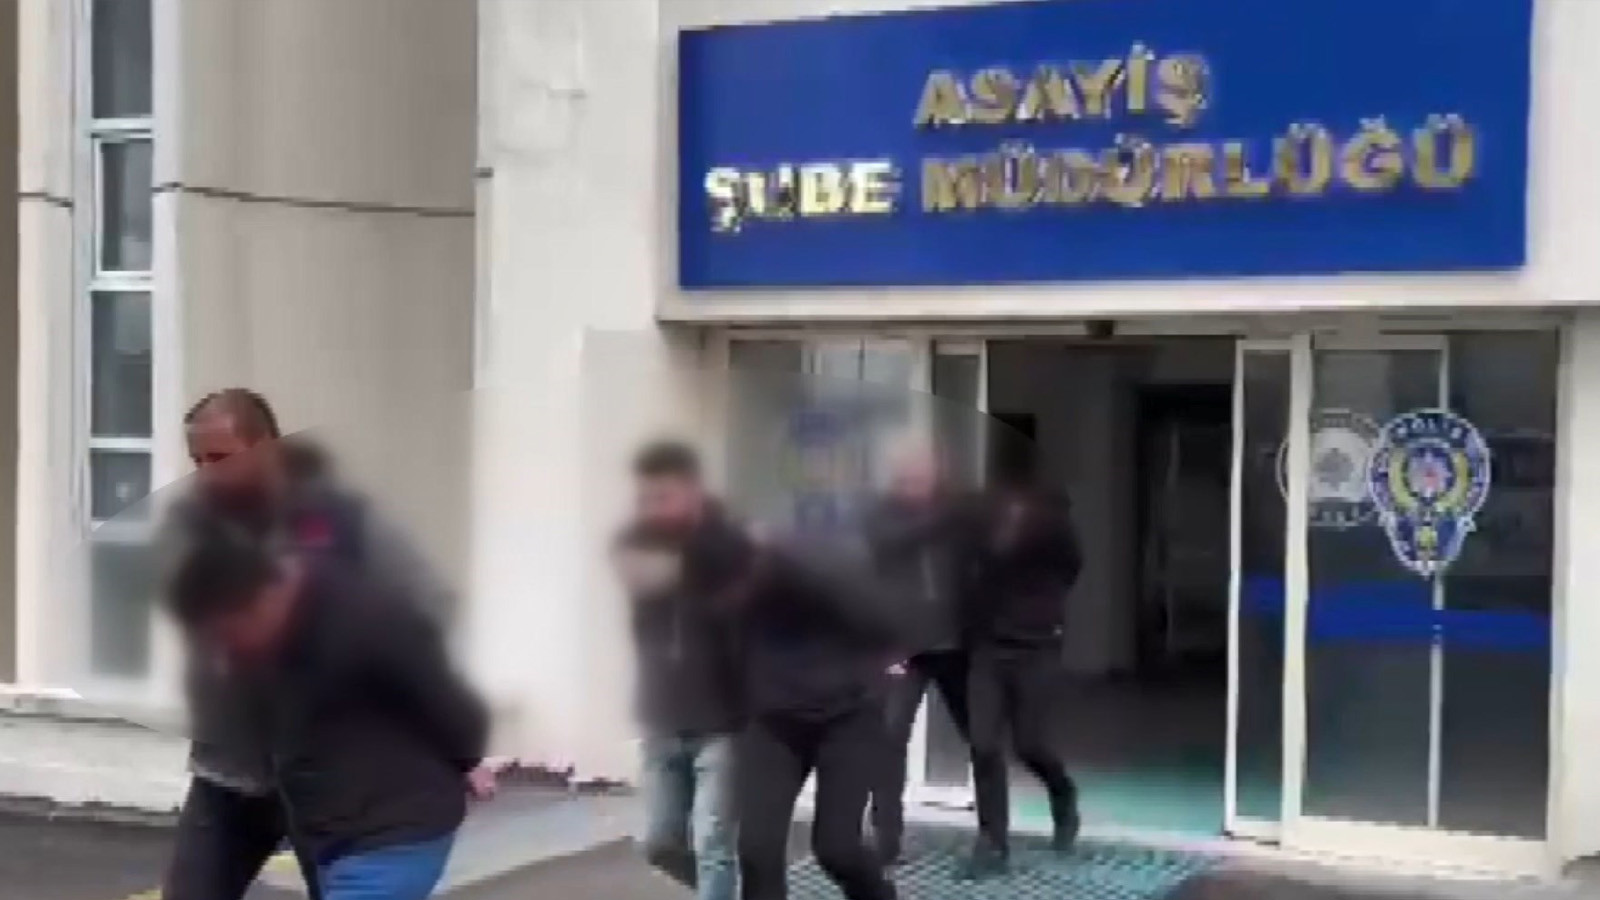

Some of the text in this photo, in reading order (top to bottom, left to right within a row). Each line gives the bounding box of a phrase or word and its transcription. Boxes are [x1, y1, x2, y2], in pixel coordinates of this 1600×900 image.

[913, 42, 1211, 128] ASAYİŞ
[705, 114, 1475, 234] ŞUBE MÜDÜRLÜĞÜ
